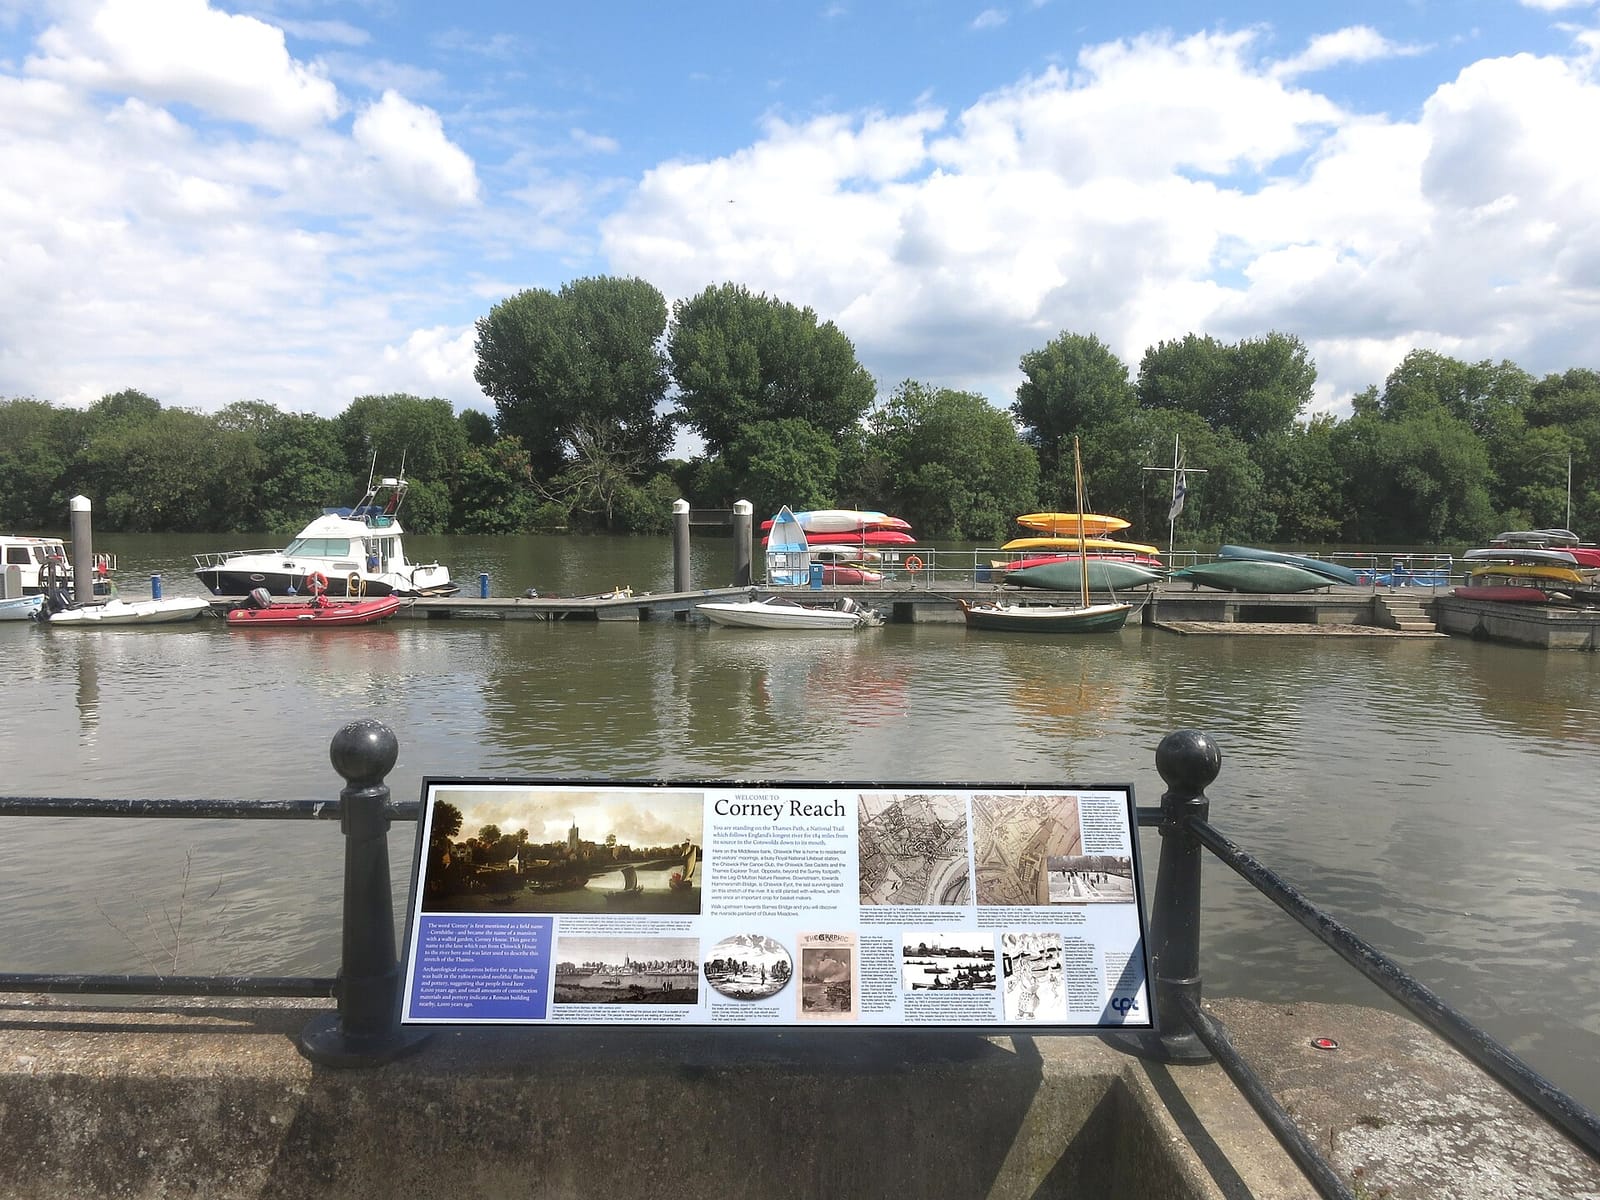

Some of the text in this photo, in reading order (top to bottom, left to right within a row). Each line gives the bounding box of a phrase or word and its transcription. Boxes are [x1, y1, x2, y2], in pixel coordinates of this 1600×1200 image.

[714, 798, 846, 821] Corney Reach
[1112, 997, 1139, 1016] cpt
